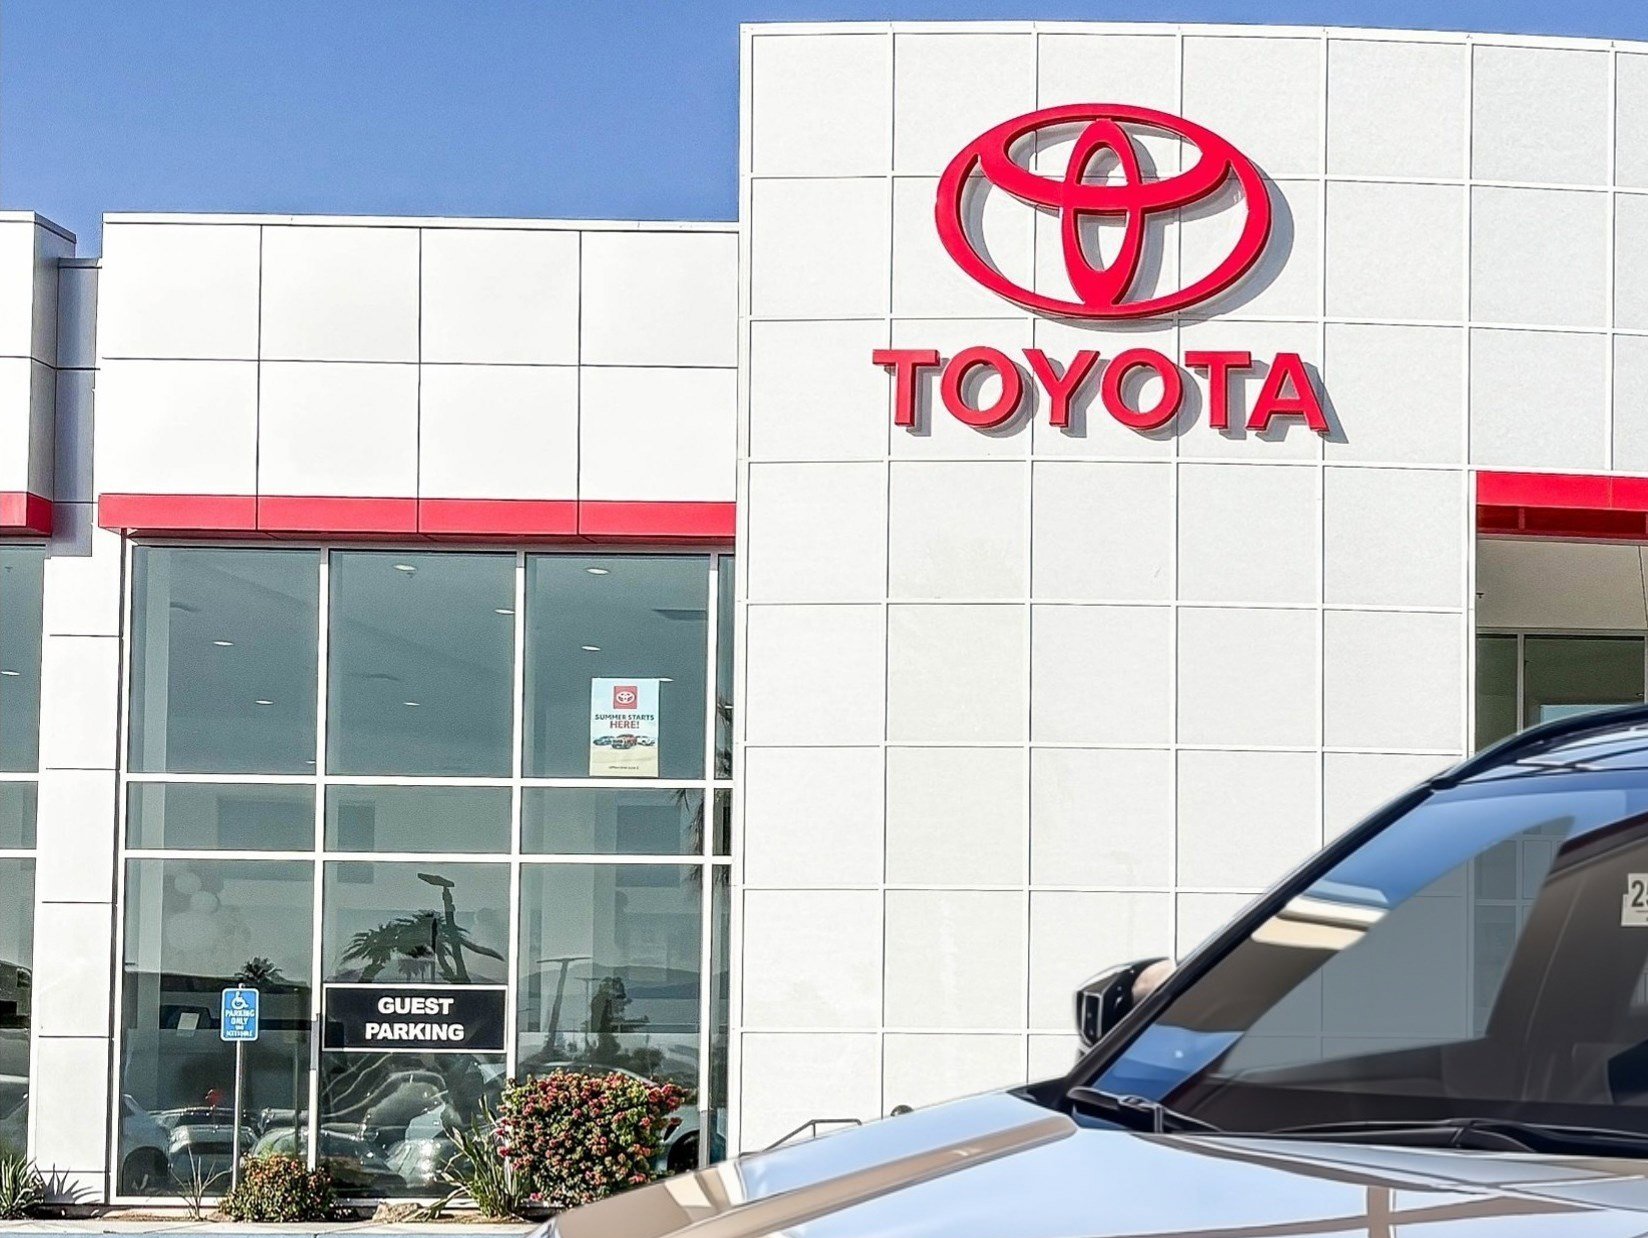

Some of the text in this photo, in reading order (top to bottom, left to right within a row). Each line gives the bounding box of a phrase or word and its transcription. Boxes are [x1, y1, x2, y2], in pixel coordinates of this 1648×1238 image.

[872, 346, 1331, 434] TOYOTA
[609, 720, 640, 729] HERE!
[377, 997, 454, 1015] GUEST
[365, 1023, 465, 1041] PARKING
